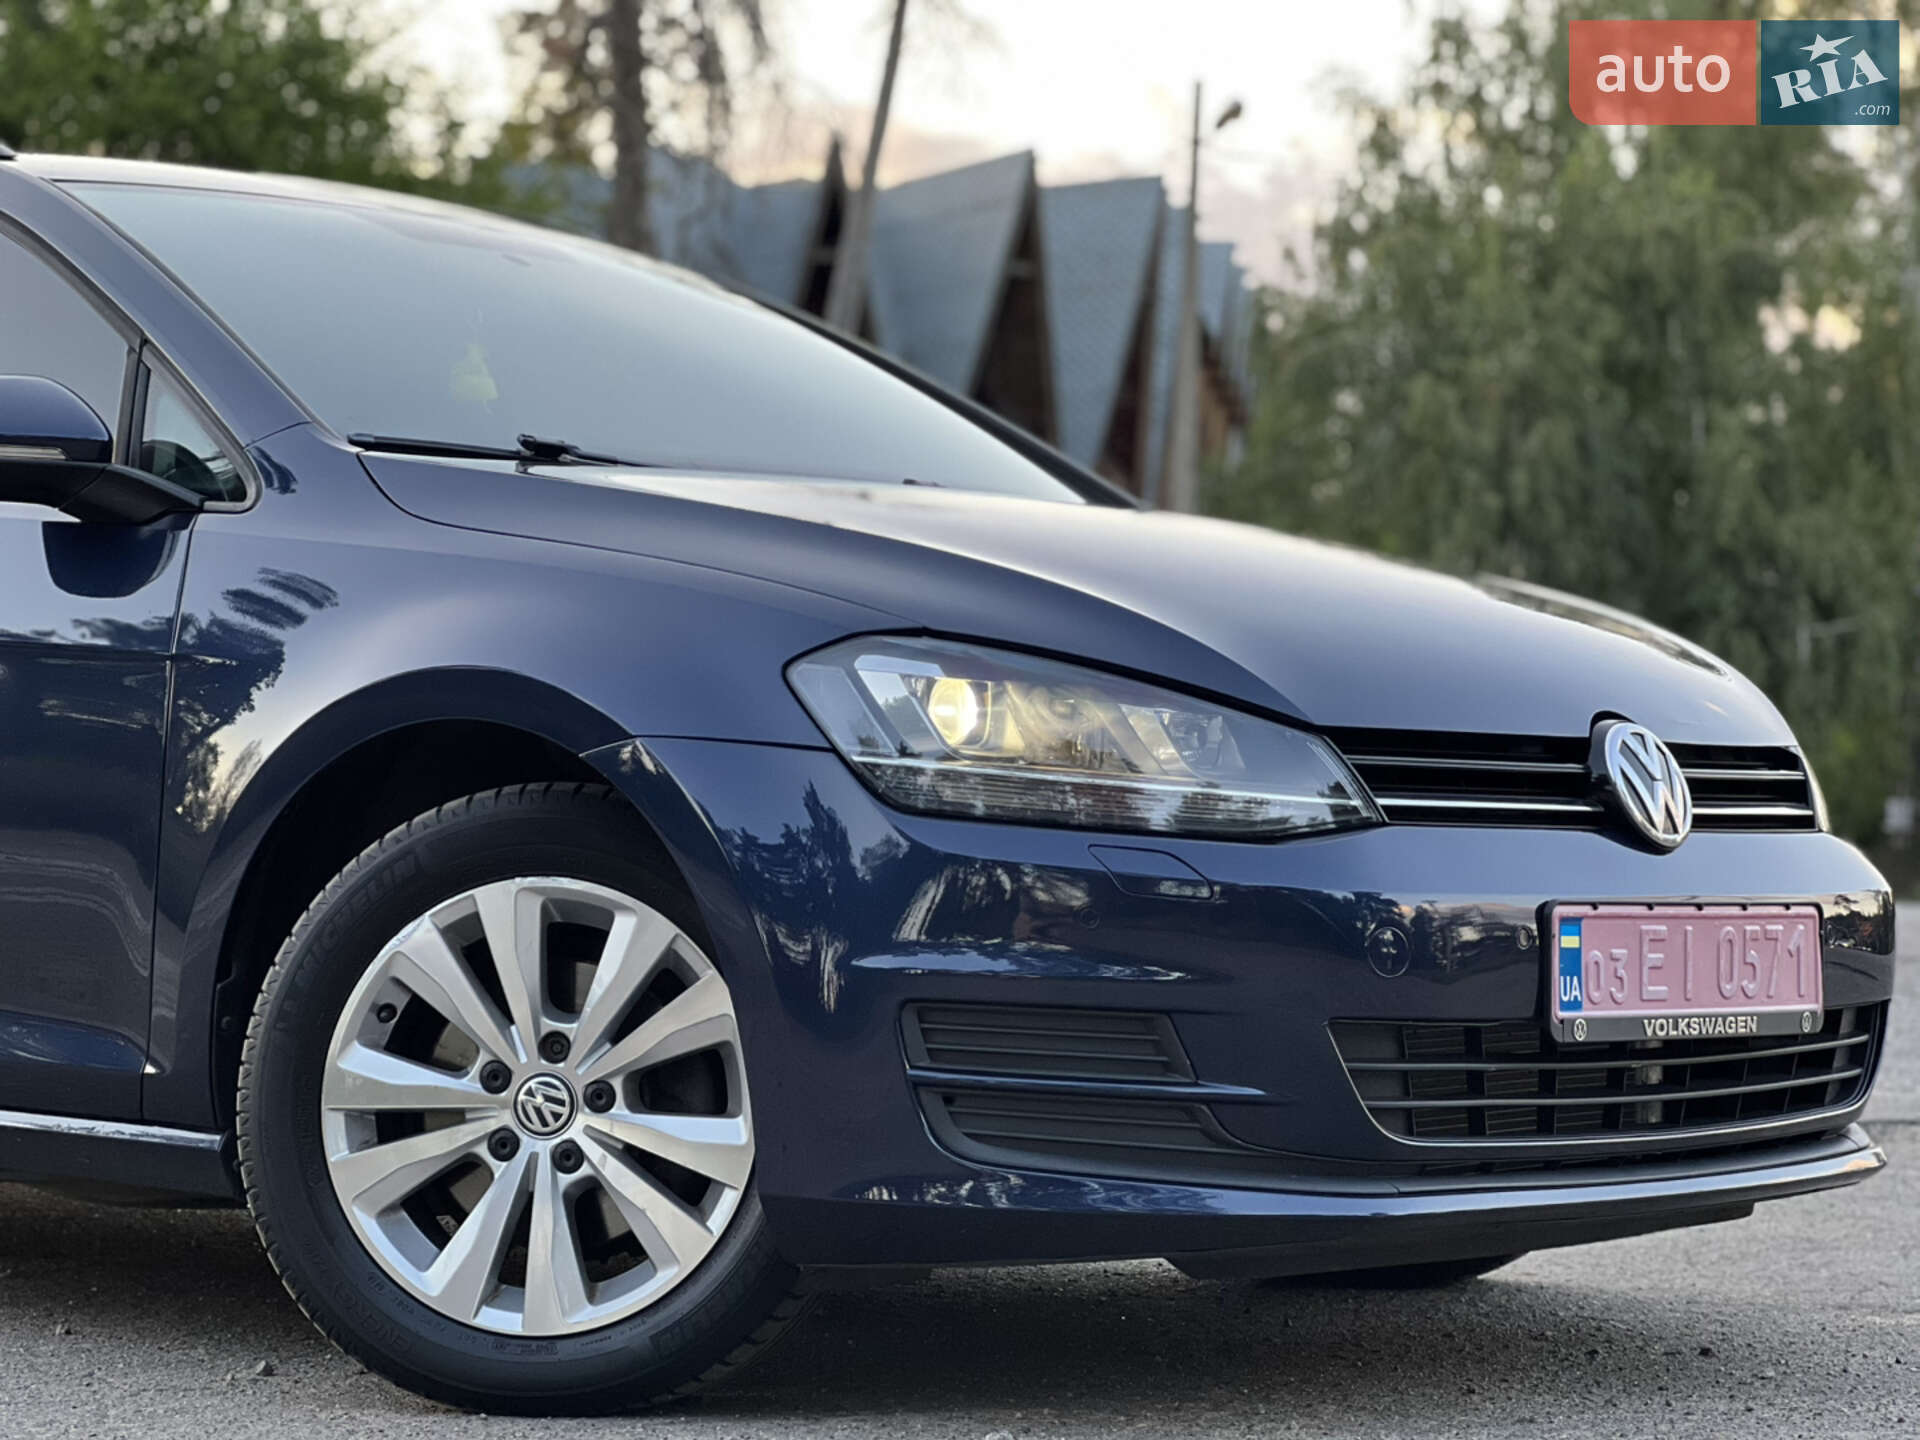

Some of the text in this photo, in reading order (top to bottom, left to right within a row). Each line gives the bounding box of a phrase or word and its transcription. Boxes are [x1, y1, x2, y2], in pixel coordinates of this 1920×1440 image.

[1586, 924, 1805, 1005] 03 EI 0571
[1560, 976, 1581, 1002] UA
[1643, 1015, 1758, 1037] VOLKSWAGEN
